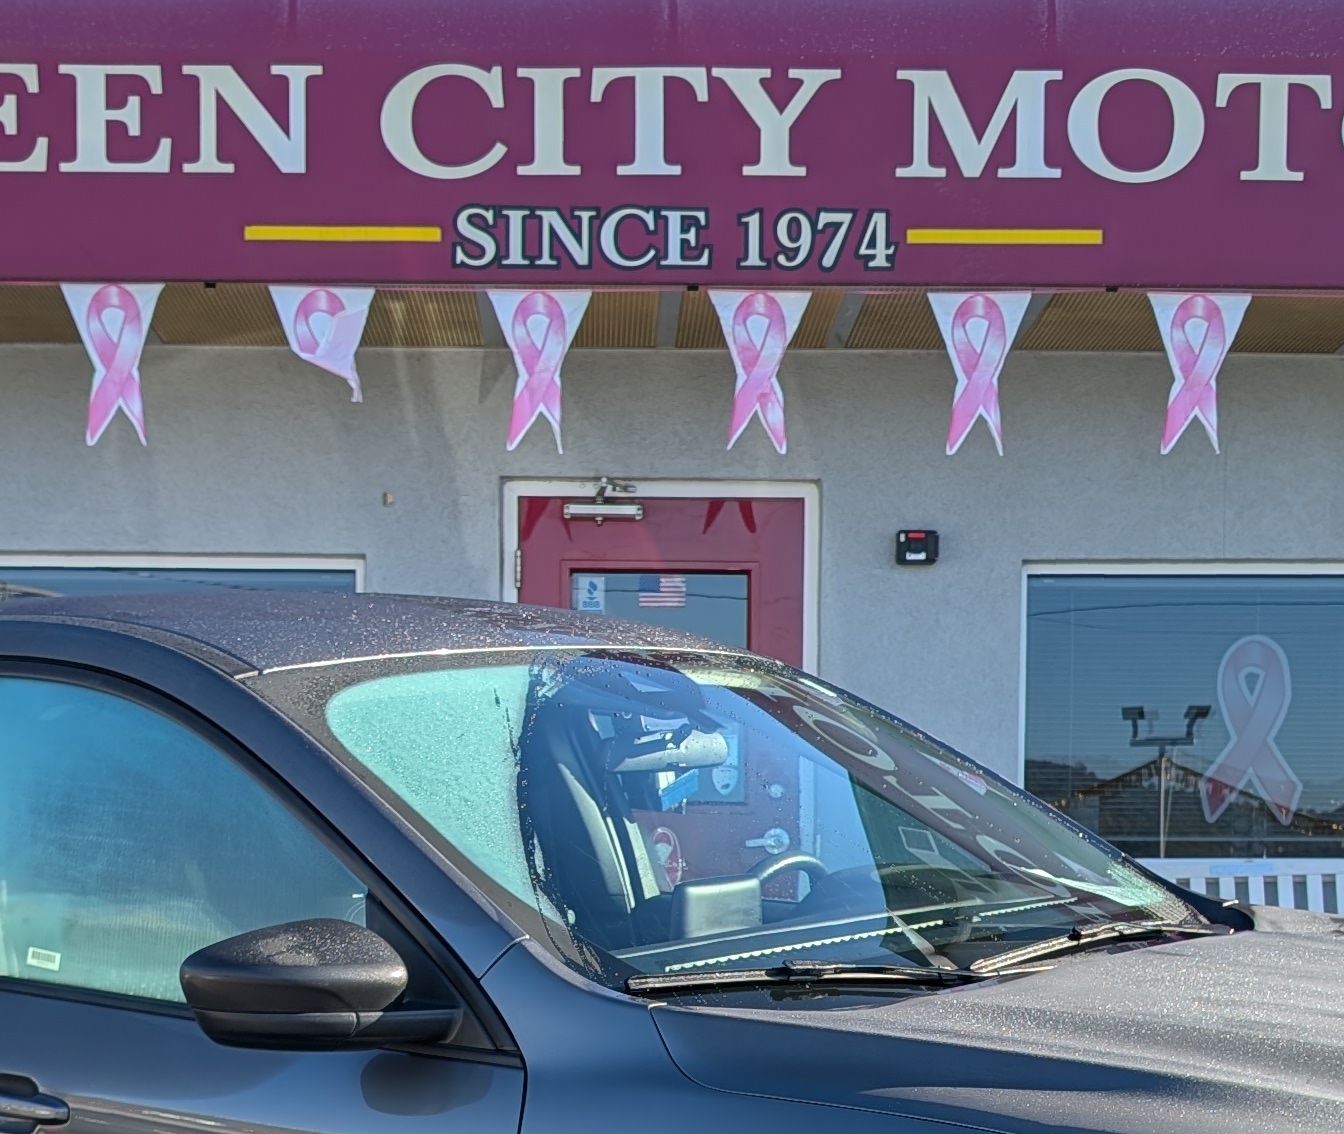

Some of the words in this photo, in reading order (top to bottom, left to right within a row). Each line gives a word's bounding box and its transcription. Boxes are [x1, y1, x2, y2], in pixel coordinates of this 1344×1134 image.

[379, 62, 842, 181] CITY
[452, 203, 712, 271] SINCE
[737, 207, 899, 273] 1974
